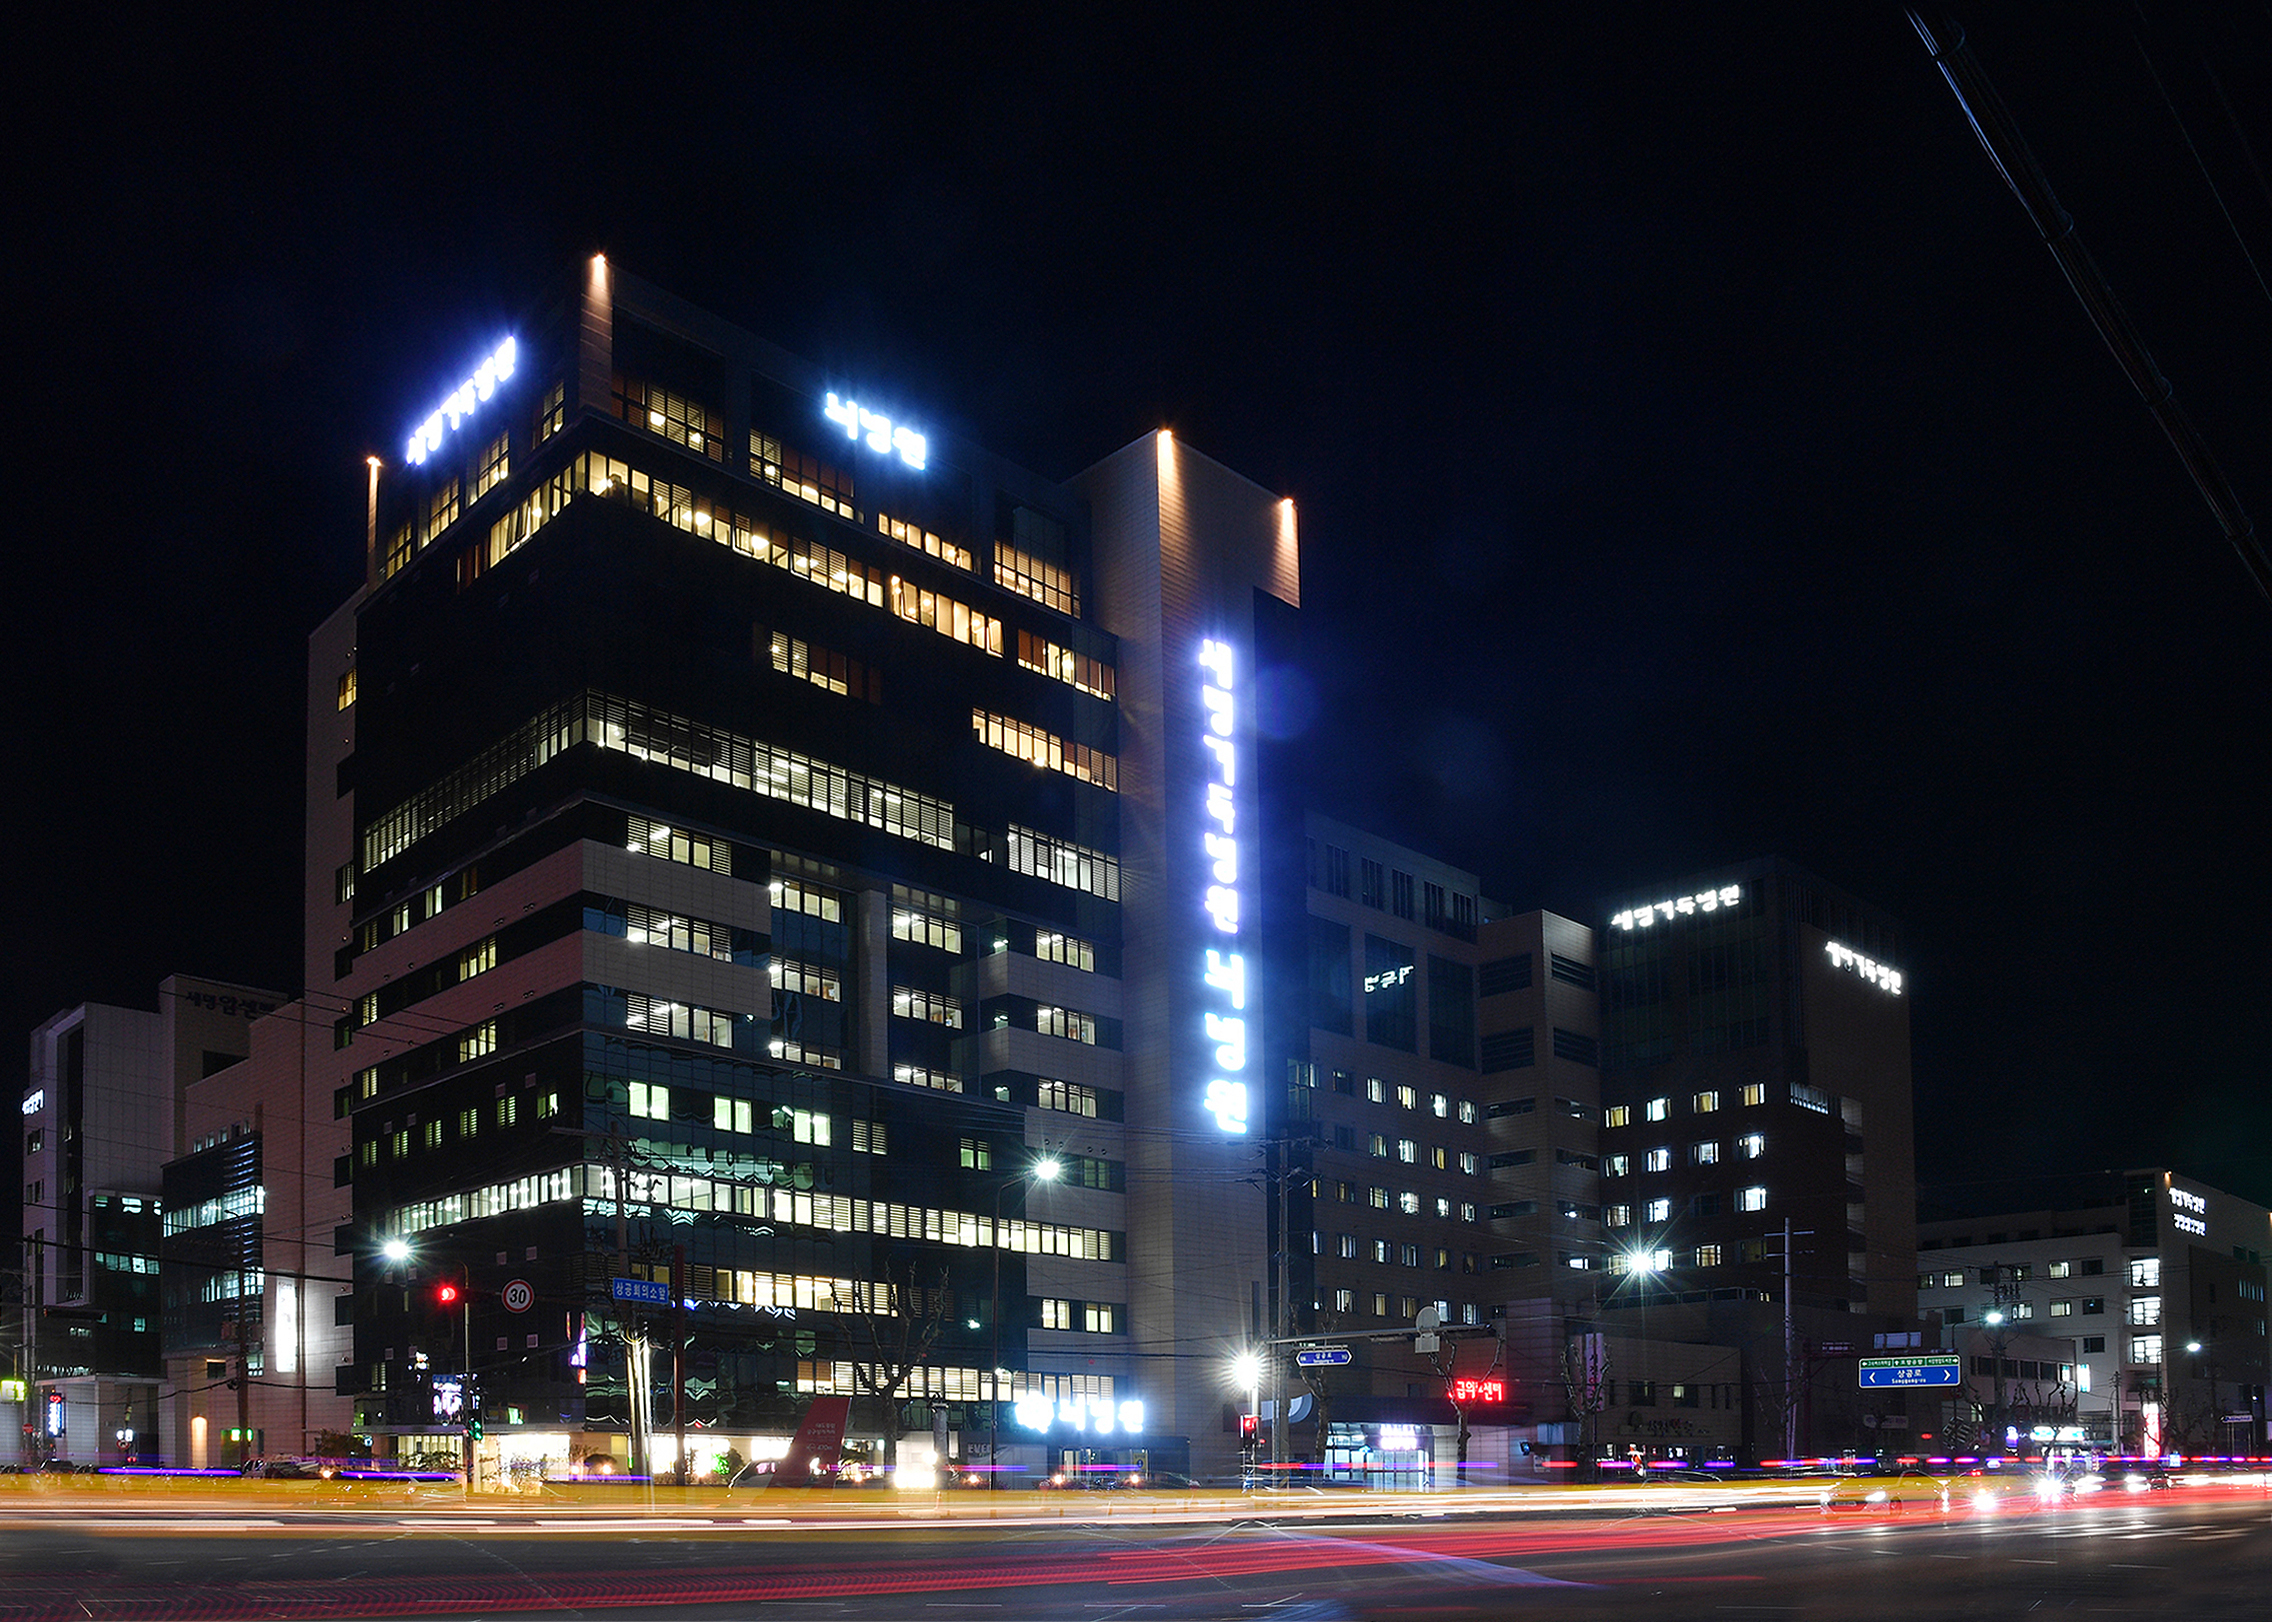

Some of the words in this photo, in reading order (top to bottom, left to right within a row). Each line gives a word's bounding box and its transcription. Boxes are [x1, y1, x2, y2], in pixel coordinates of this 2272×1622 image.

[1611, 884, 1740, 931] 세명기독병원
[1825, 941, 1902, 995] 세명기독병원
[509, 1288, 527, 1304] 30
[616, 1281, 666, 1301] 상공회의소앞
[1897, 1369, 1922, 1378] 상공로
